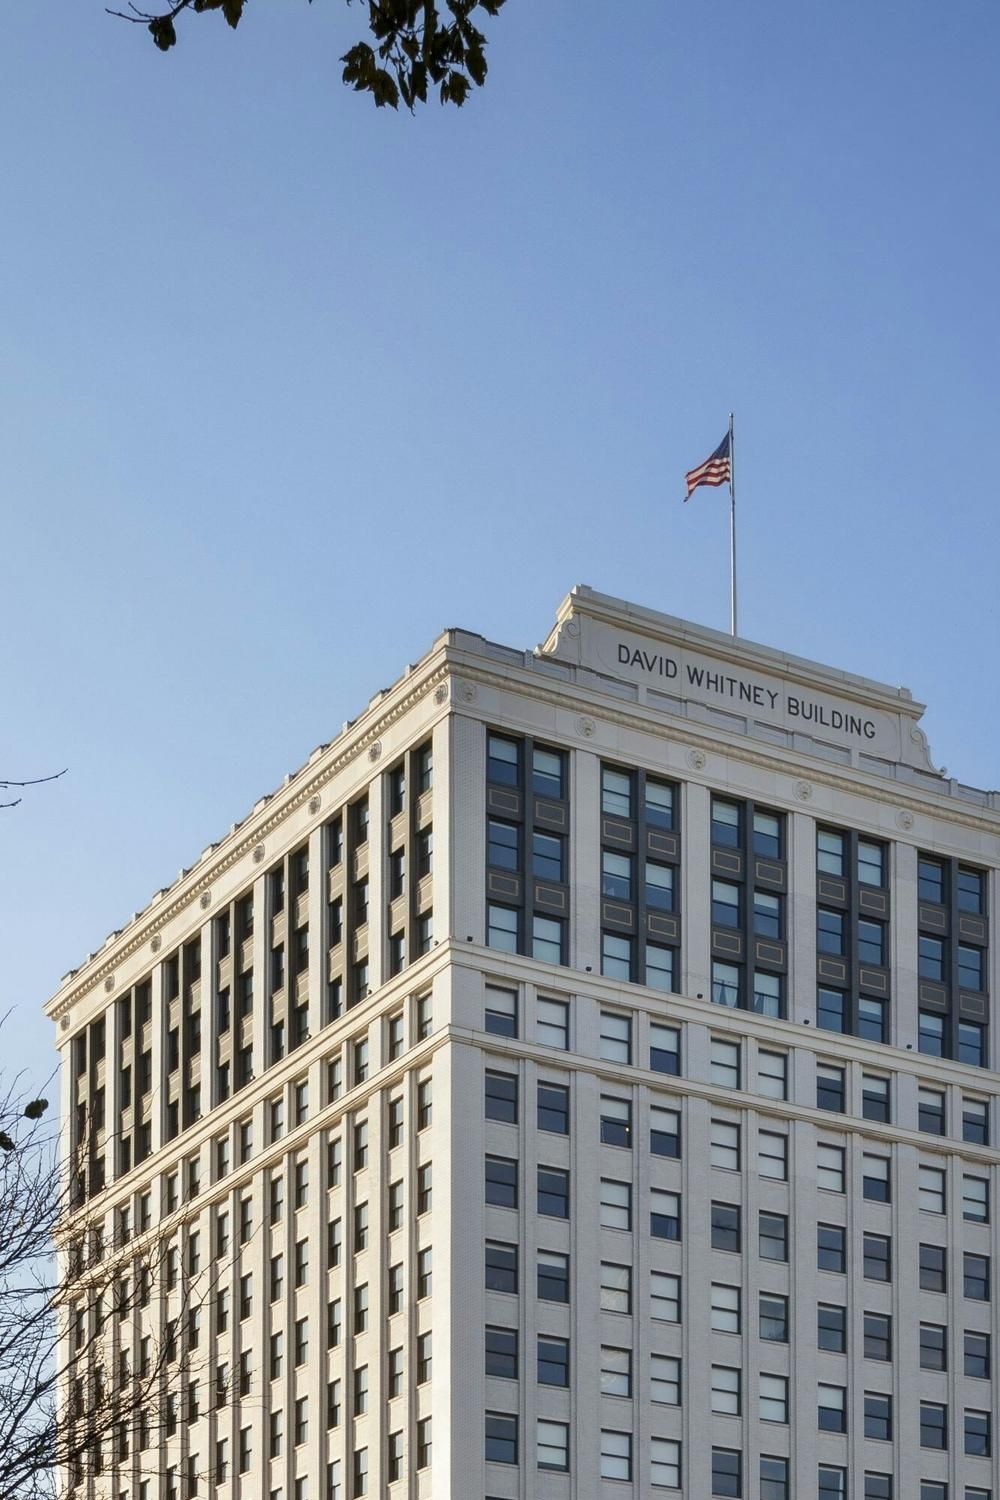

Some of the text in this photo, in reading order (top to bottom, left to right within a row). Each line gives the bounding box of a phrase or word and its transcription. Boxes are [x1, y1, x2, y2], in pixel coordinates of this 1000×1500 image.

[617, 643, 876, 739] DAVID WHITNEY BUILDING
